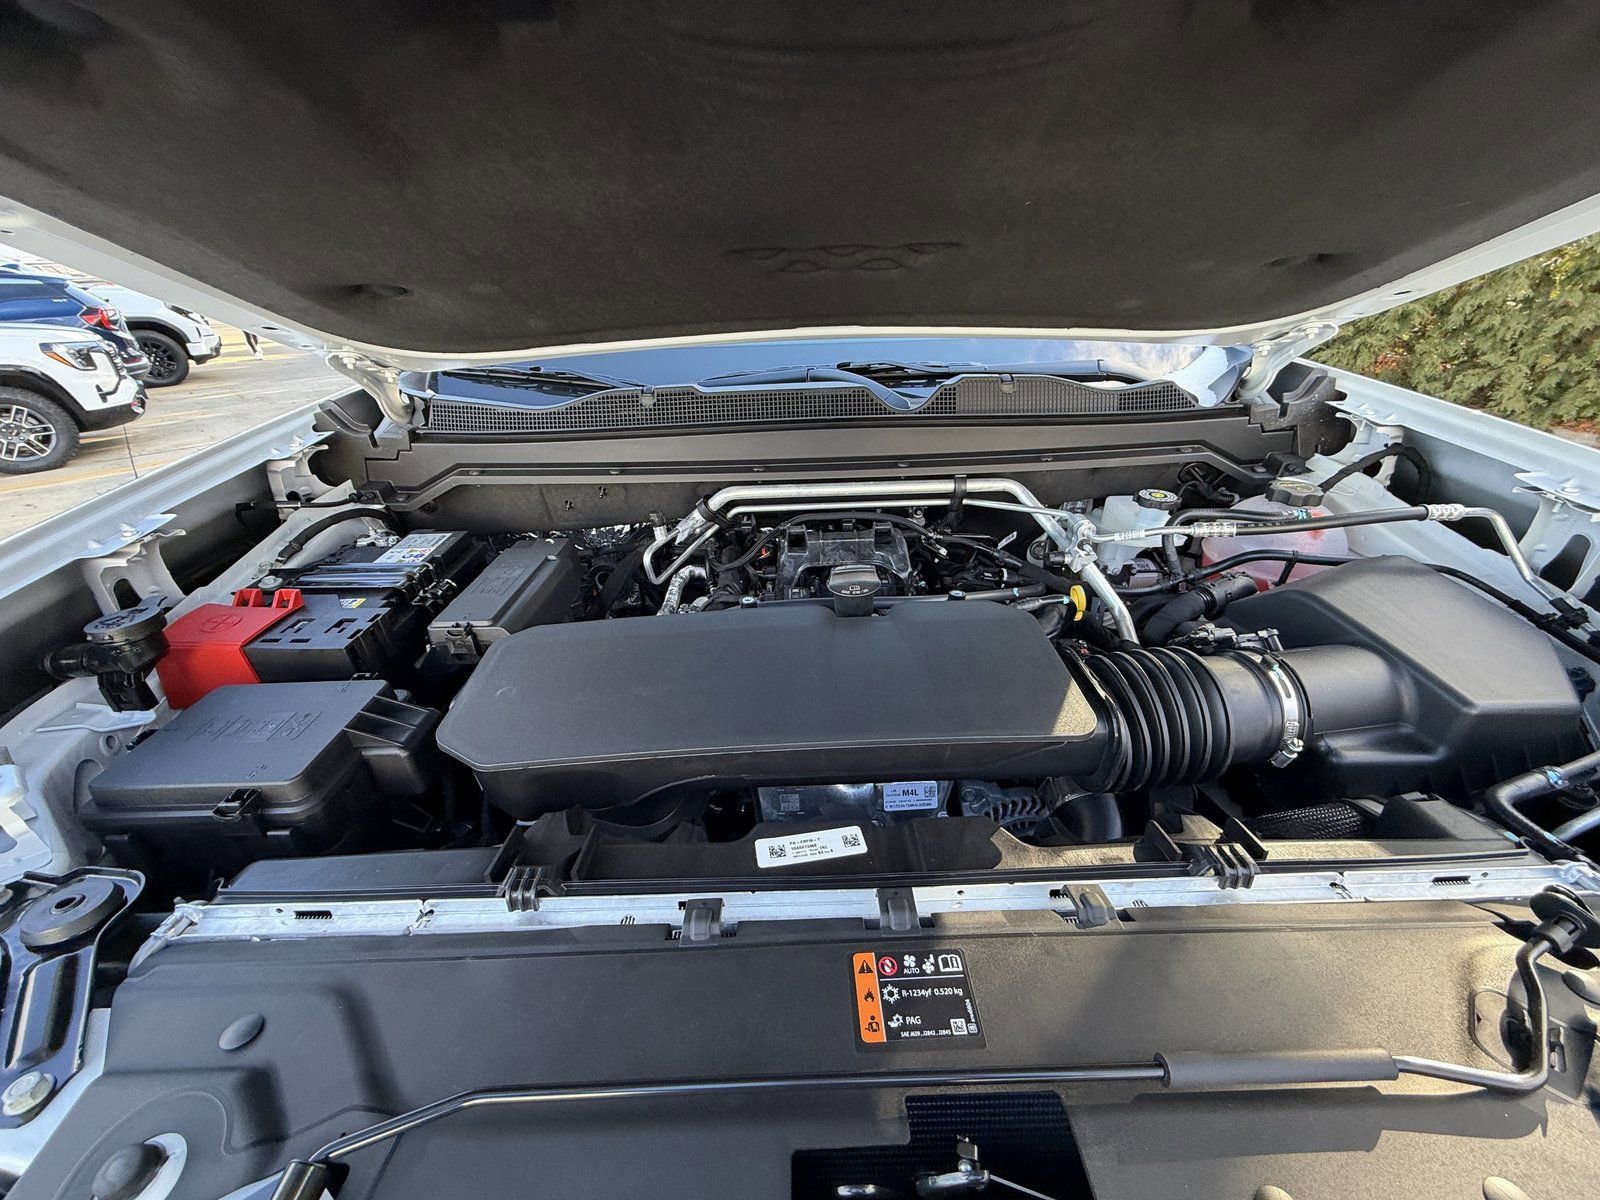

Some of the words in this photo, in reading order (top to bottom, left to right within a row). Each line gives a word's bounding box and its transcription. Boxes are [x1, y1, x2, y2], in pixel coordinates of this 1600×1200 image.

[902, 788, 919, 797] M4L
[903, 967, 920, 975] AUTO
[901, 988, 932, 998] R-1234yf
[934, 987, 953, 996] 0.520
[954, 986, 963, 996] kg
[905, 1016, 922, 1025] PAG
